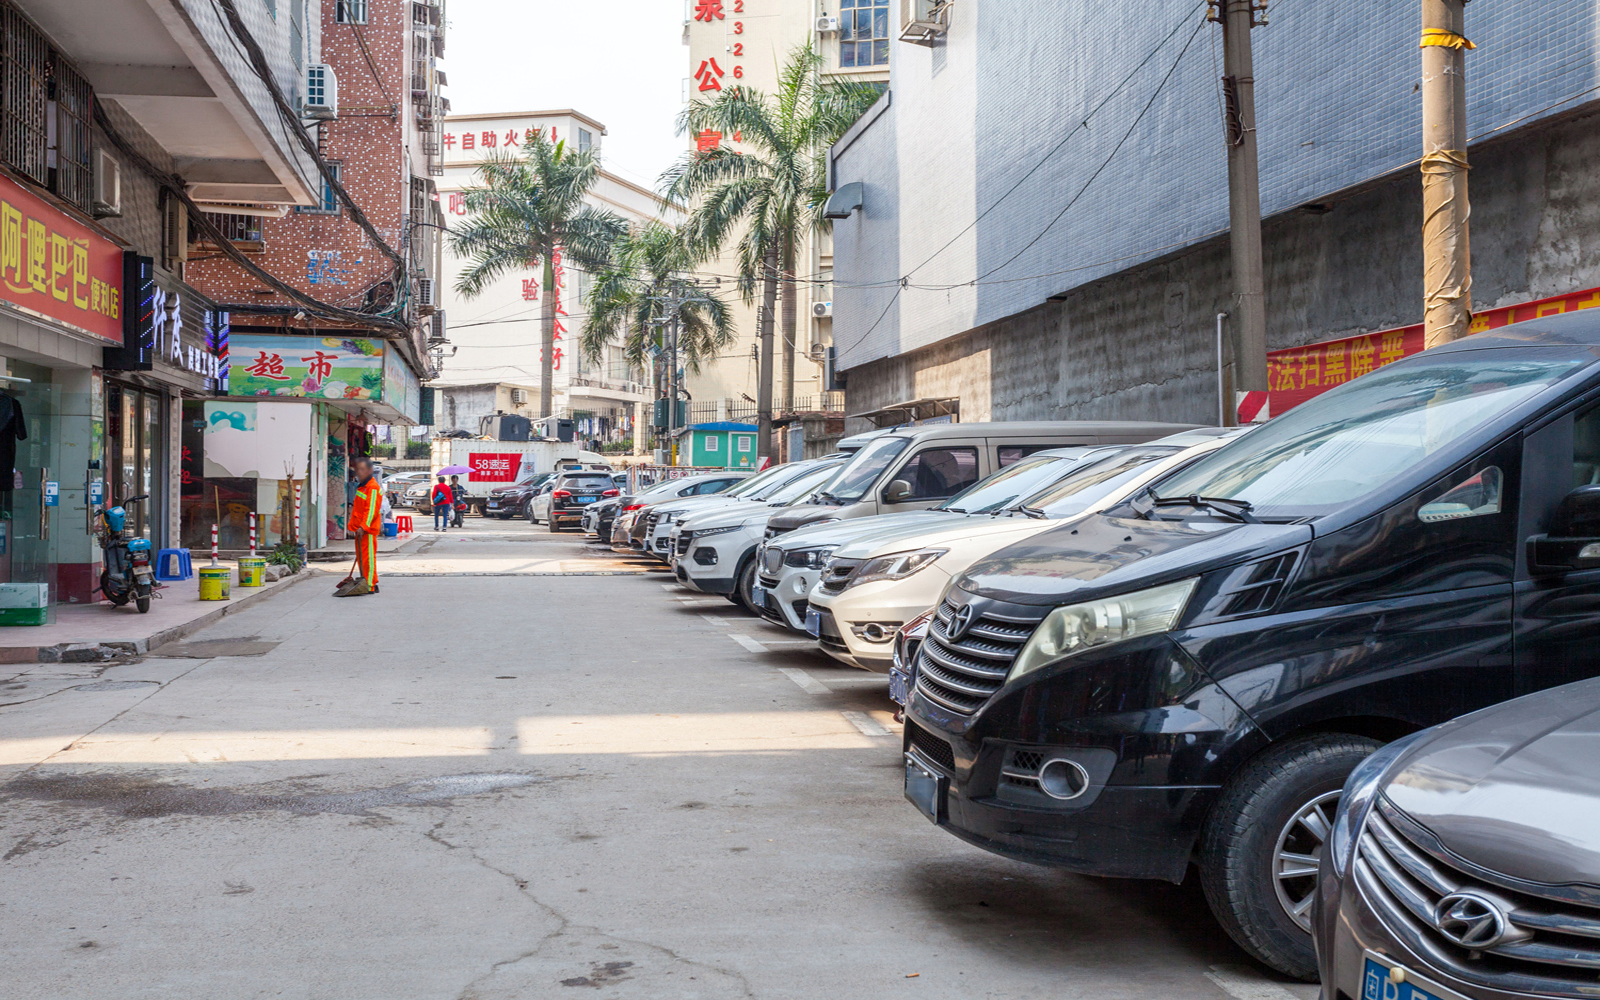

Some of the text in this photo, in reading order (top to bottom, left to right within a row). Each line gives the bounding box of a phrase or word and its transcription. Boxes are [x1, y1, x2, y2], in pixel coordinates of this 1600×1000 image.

[91, 275, 119, 320] 便利店
[244, 350, 339, 386] 超市
[422, 389, 433, 423] 2元店
[475, 459, 510, 470] 58速运
